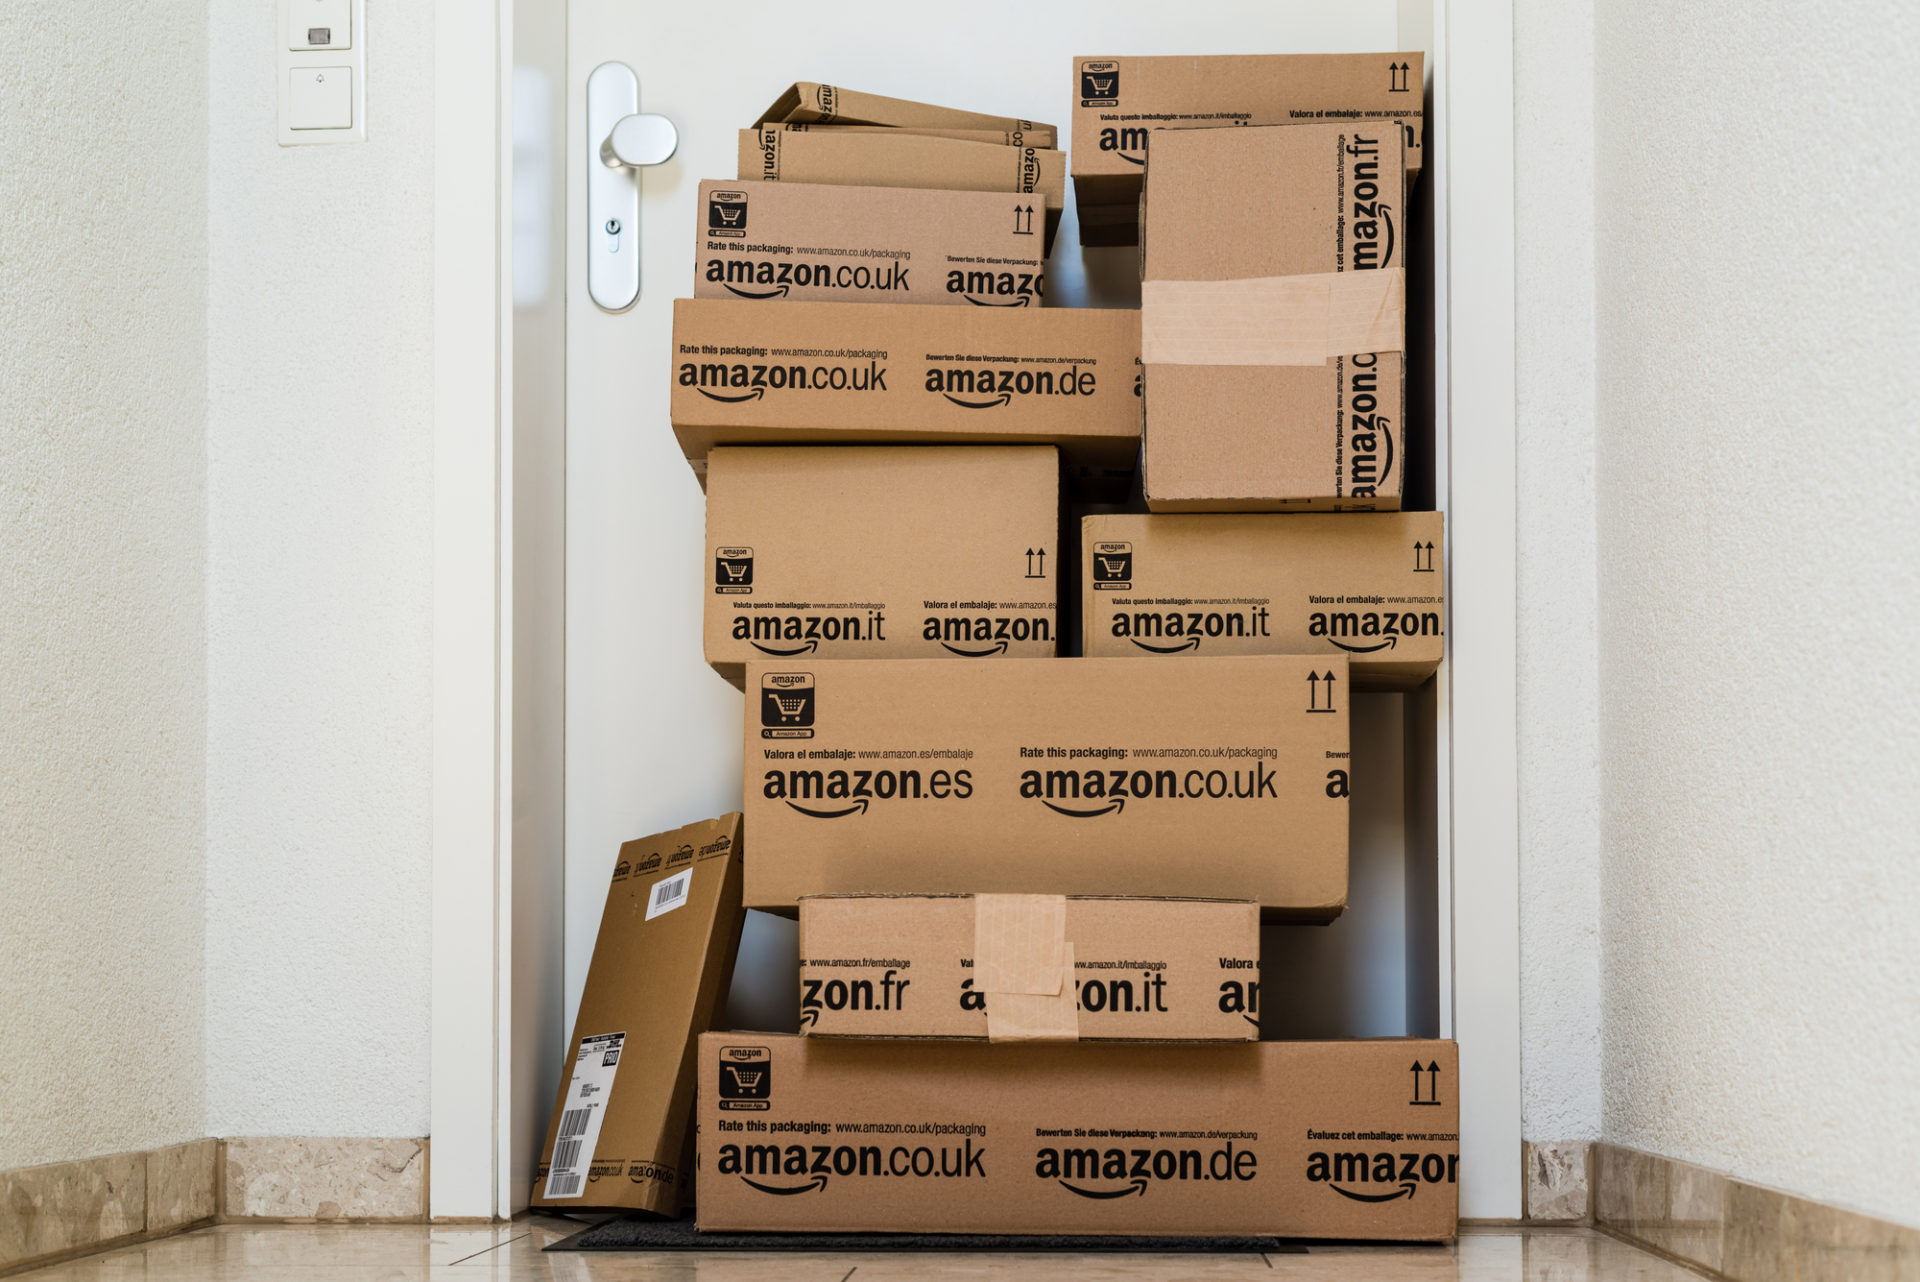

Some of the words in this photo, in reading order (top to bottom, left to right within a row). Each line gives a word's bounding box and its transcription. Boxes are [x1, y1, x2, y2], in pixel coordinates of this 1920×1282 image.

[1141, 113, 1178, 121] imballaggio:
[1289, 110, 1314, 118] Valora
[1316, 110, 1323, 118] el
[1325, 109, 1363, 119] embalaje:
[1346, 133, 1379, 270] mazon.fr
[1336, 215, 1346, 252] emballage:
[707, 241, 726, 251] Rate
[729, 242, 745, 251] this
[747, 244, 793, 255] packaging:
[797, 247, 911, 259] www.amazon.co.uk/packaging
[1002, 258, 1038, 266] Verpackung:
[706, 259, 910, 291] amazon.co.uk
[680, 345, 699, 354] Rate
[701, 345, 718, 355] this
[720, 346, 768, 357] packaging:
[771, 348, 888, 359] www.amazon.co.uk/packaging
[983, 355, 1019, 364] Verpackung:
[1021, 357, 1097, 365] www.amazon.de/verpackung
[679, 361, 887, 391] amazon.co.uk
[925, 365, 1096, 396] amazon.de
[923, 600, 948, 609] Valora
[950, 600, 957, 608] el
[959, 600, 997, 610] embalaje:
[1155, 598, 1192, 606] imballaggio:
[1309, 595, 1334, 603] Valora
[1336, 595, 1344, 603] el
[1346, 595, 1385, 605] embalaje:
[732, 610, 886, 641] amazon.it
[1111, 606, 1270, 637] amazon.it
[923, 617, 1055, 641] amazon.
[771, 675, 805, 683] amazon
[764, 749, 794, 759] Valora
[797, 749, 806, 759] el
[809, 749, 856, 760] embalaje:
[858, 749, 973, 760] www.amazon.es/embalaje
[1020, 747, 1044, 758] Rate
[1046, 747, 1067, 758] this
[1069, 747, 1128, 760] packaging:
[1132, 748, 1278, 760] www.amazon.co.uk/packaging
[763, 769, 973, 799] amazon.es
[1019, 761, 1278, 798] amazon.co.uk
[810, 958, 910, 969] www.amazon.fr/emballage
[1219, 957, 1253, 969] Valora
[803, 970, 910, 1010] zon.fr
[729, 1049, 762, 1057] amazon
[718, 1120, 743, 1132] Rate
[747, 1120, 767, 1132] this
[770, 1121, 831, 1135] packaging:
[836, 1122, 986, 1136] www.amazon.co.uk/packaging
[1036, 1128, 1072, 1137] Bewerten
[1074, 1128, 1086, 1137] Sie
[1088, 1128, 1108, 1137] diese
[1110, 1129, 1157, 1139] Verpackung:
[1159, 1130, 1257, 1140] www.amazon.de/verpackung
[1307, 1128, 1339, 1140] Évaluez
[1342, 1131, 1355, 1140] cet
[1357, 1131, 1403, 1142] emballage:
[718, 1139, 986, 1177] amazon.co.uk
[1036, 1141, 1257, 1181] amazon.de
